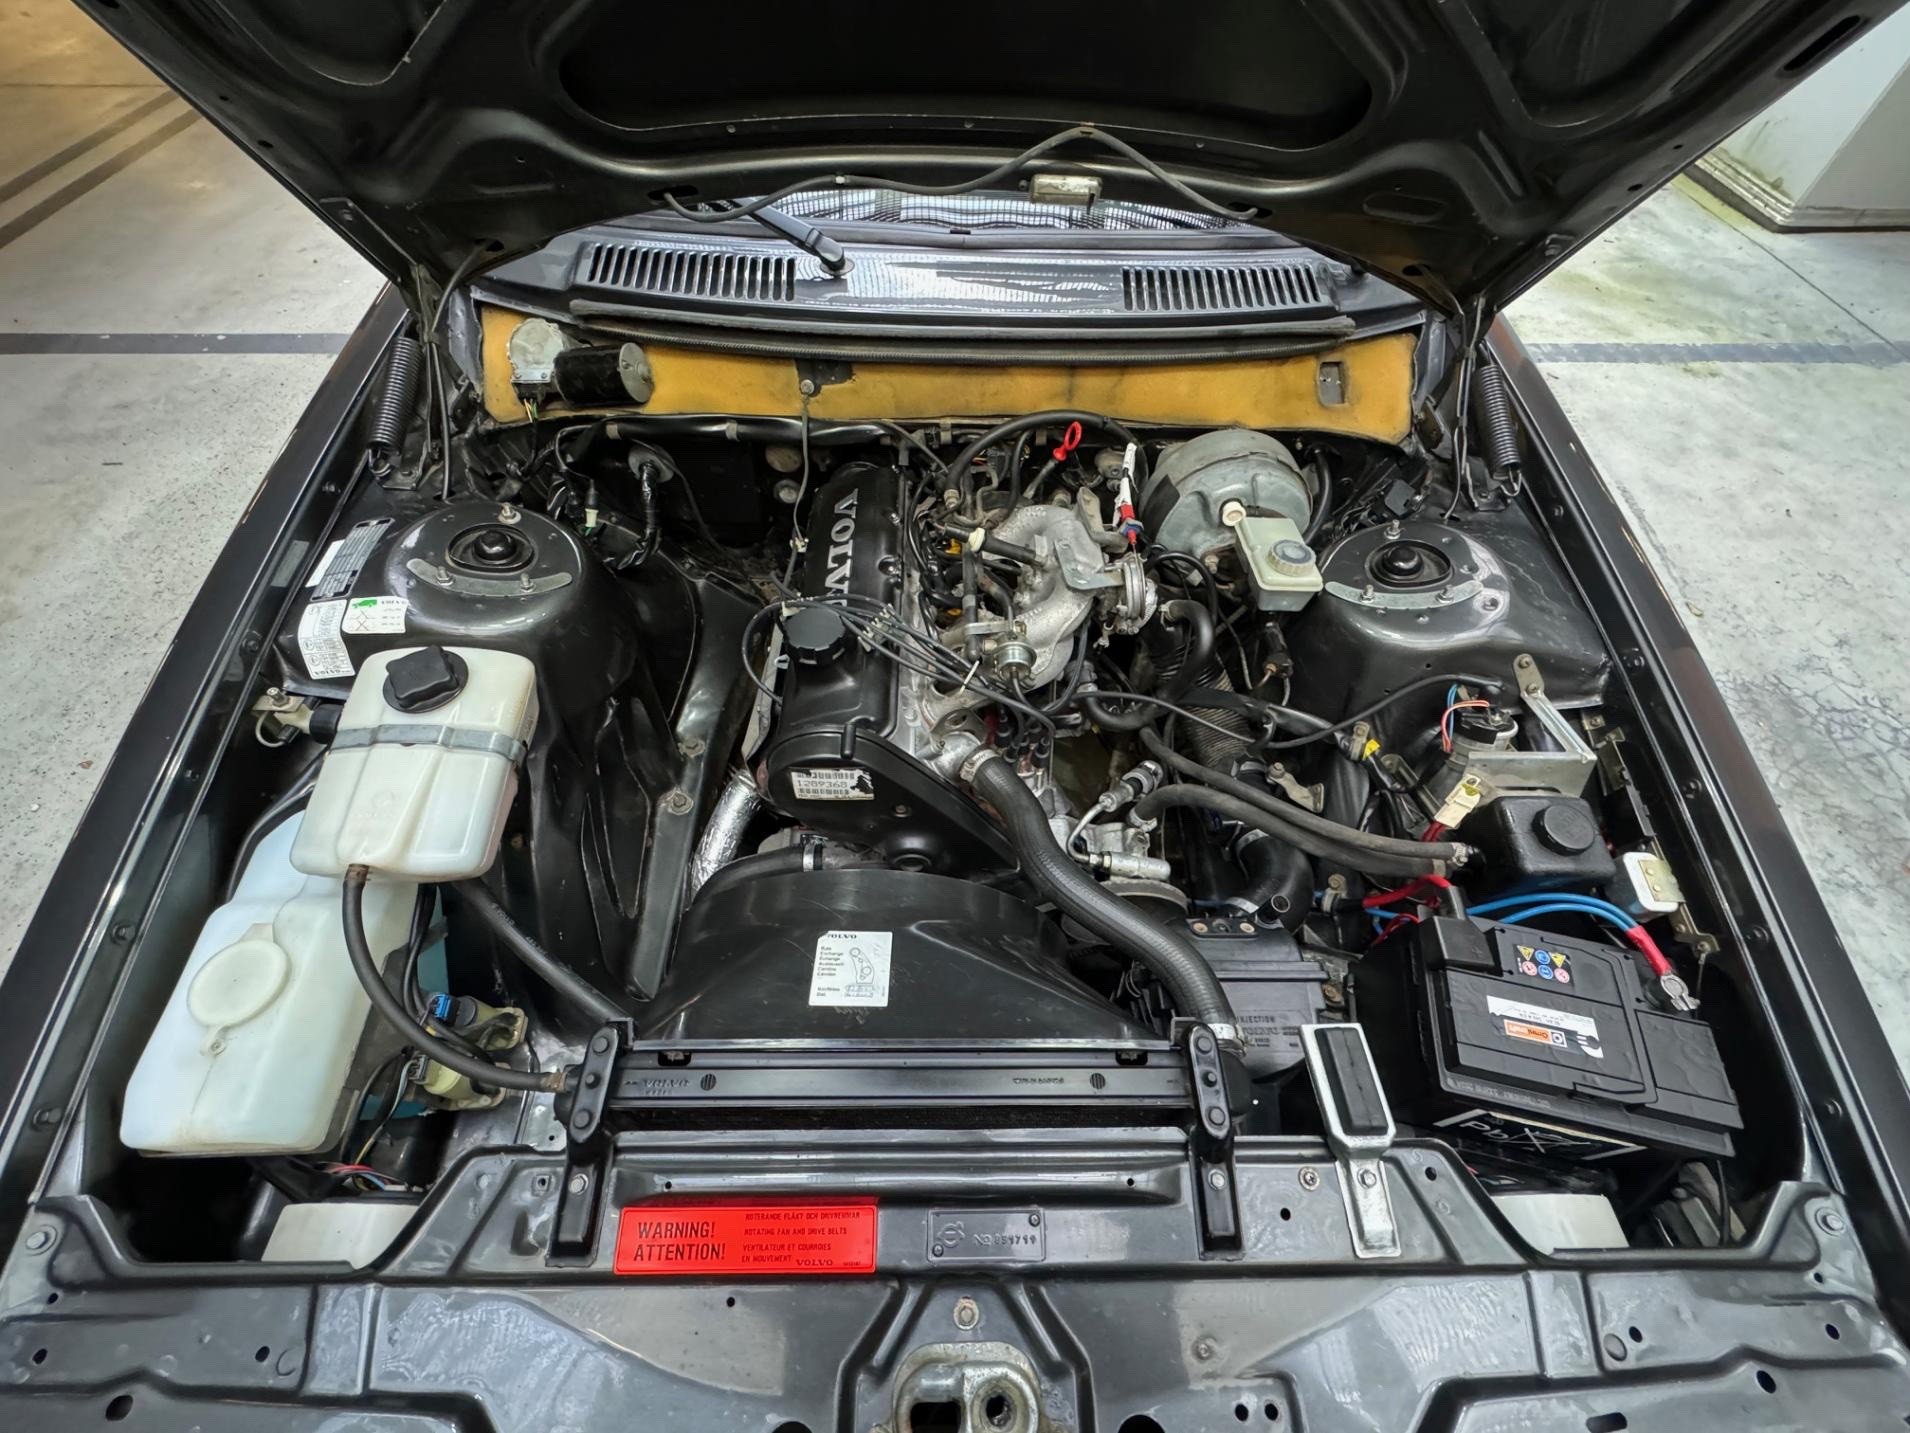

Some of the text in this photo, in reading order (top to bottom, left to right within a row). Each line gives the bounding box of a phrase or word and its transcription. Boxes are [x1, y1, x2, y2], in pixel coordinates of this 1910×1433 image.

[638, 1221, 715, 1238] WARNING!
[744, 1228, 775, 1236] ROTATING
[828, 1227, 847, 1235] BELTS
[787, 1243, 796, 1251] ET
[633, 1243, 726, 1261] ATTENTION!
[741, 1255, 750, 1263] EN
